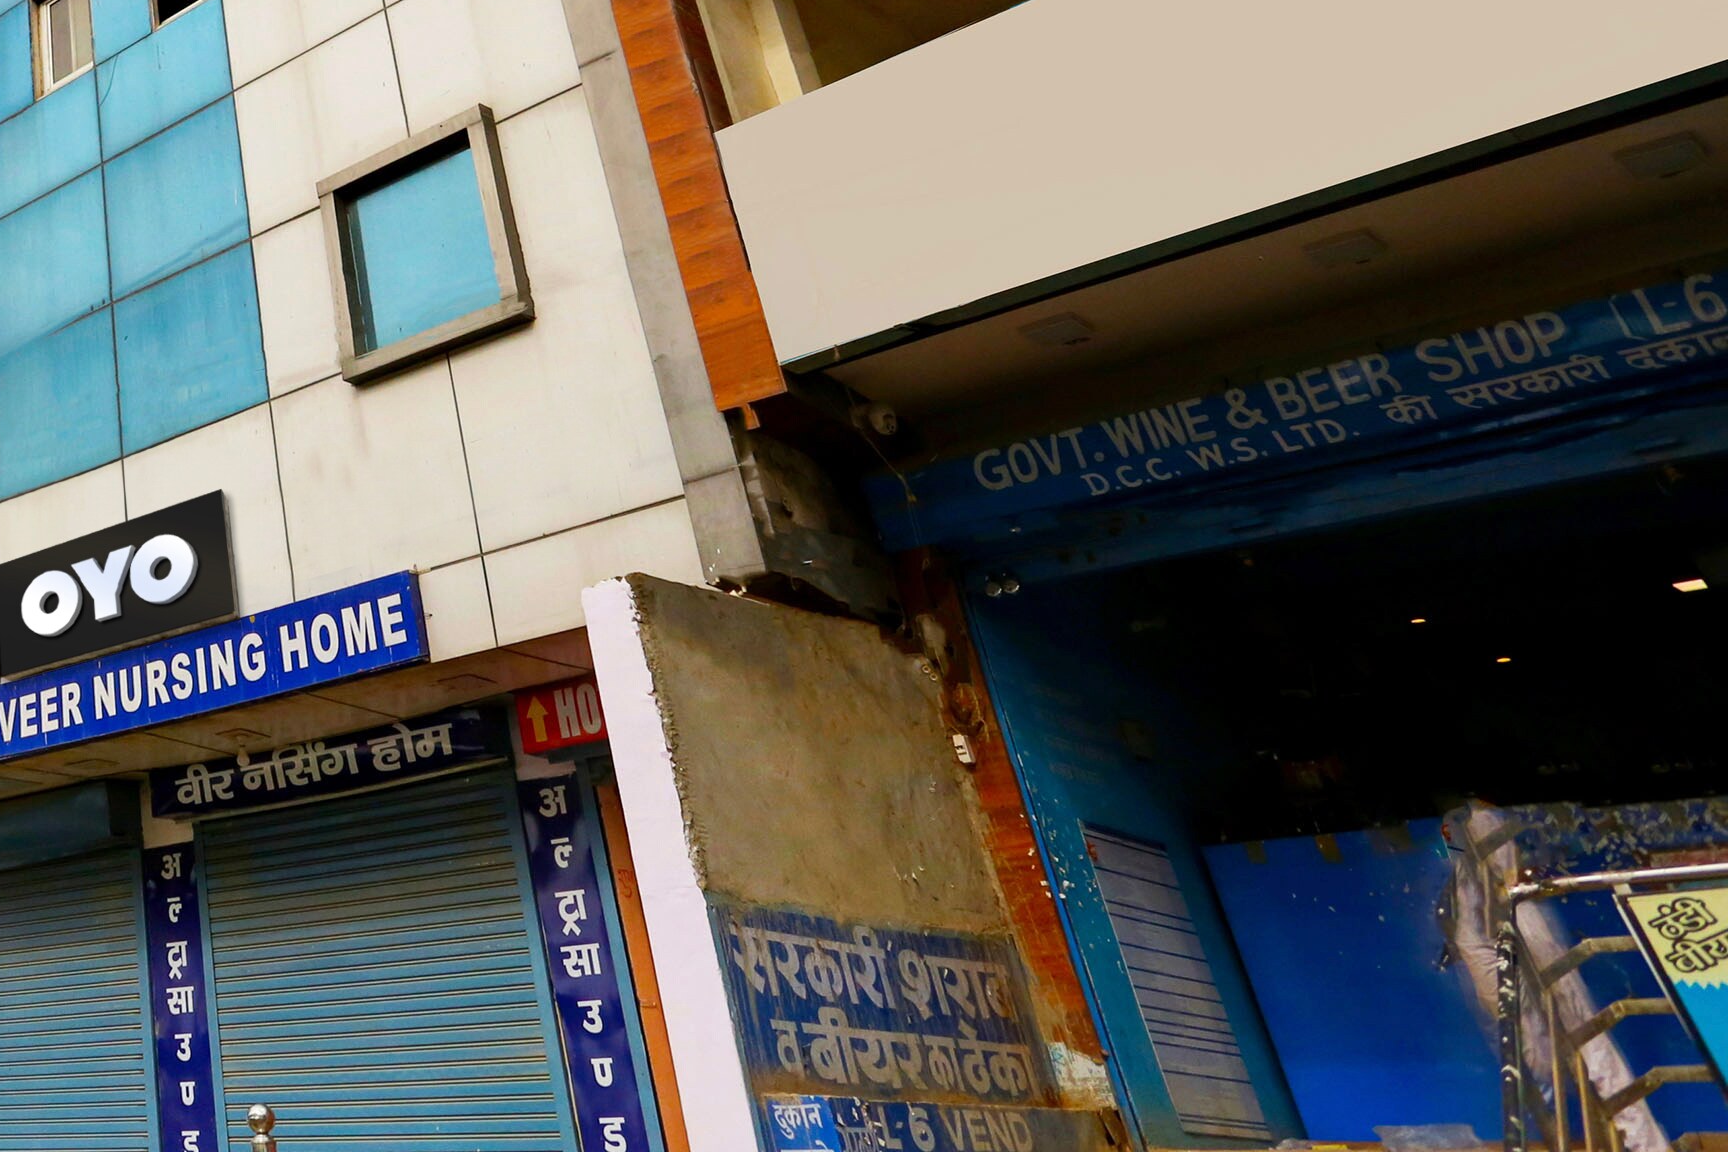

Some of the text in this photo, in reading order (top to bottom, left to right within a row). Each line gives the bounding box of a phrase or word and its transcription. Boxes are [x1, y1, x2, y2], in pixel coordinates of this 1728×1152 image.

[973, 427, 1106, 493] GOVT.
[1099, 396, 1217, 461] WINE
[1224, 387, 1265, 432] &
[1270, 353, 1398, 422] BEER
[1415, 310, 1566, 385] SHOP
[1279, 420, 1362, 456] LTD.
[1380, 393, 1440, 428] की
[1448, 352, 1612, 409] सरकारी
[20, 533, 200, 638] OYO
[92, 632, 268, 722] NURSING
[279, 593, 409, 673] HOME
[174, 763, 235, 806] वीर
[366, 722, 454, 772] होम
[729, 925, 896, 1010] सरकारी
[771, 1104, 824, 1140] दुकान
[938, 1108, 1033, 1152] VEND
